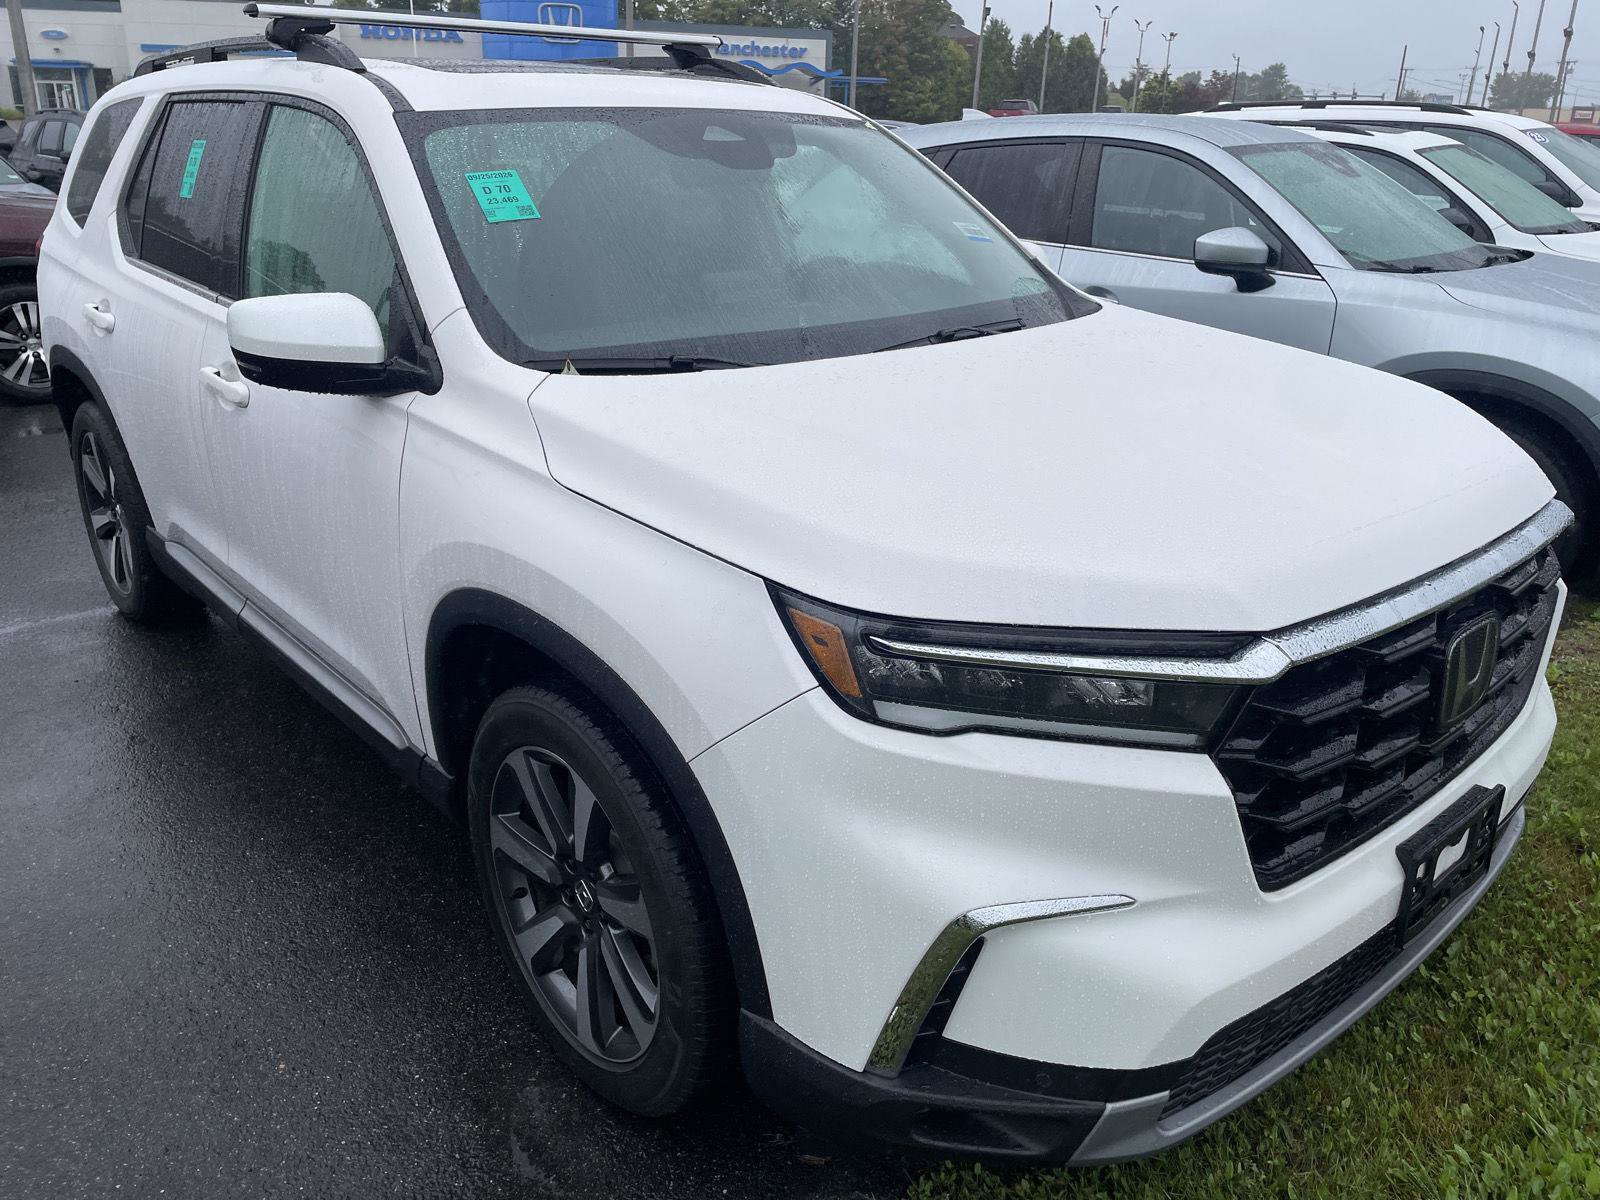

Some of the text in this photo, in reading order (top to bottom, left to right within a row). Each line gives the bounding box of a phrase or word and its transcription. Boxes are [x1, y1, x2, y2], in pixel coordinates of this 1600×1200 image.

[360, 24, 464, 43] HONDA
[715, 40, 808, 58] anchester
[467, 171, 513, 181] 09/25/2026
[482, 184, 512, 195] D 70
